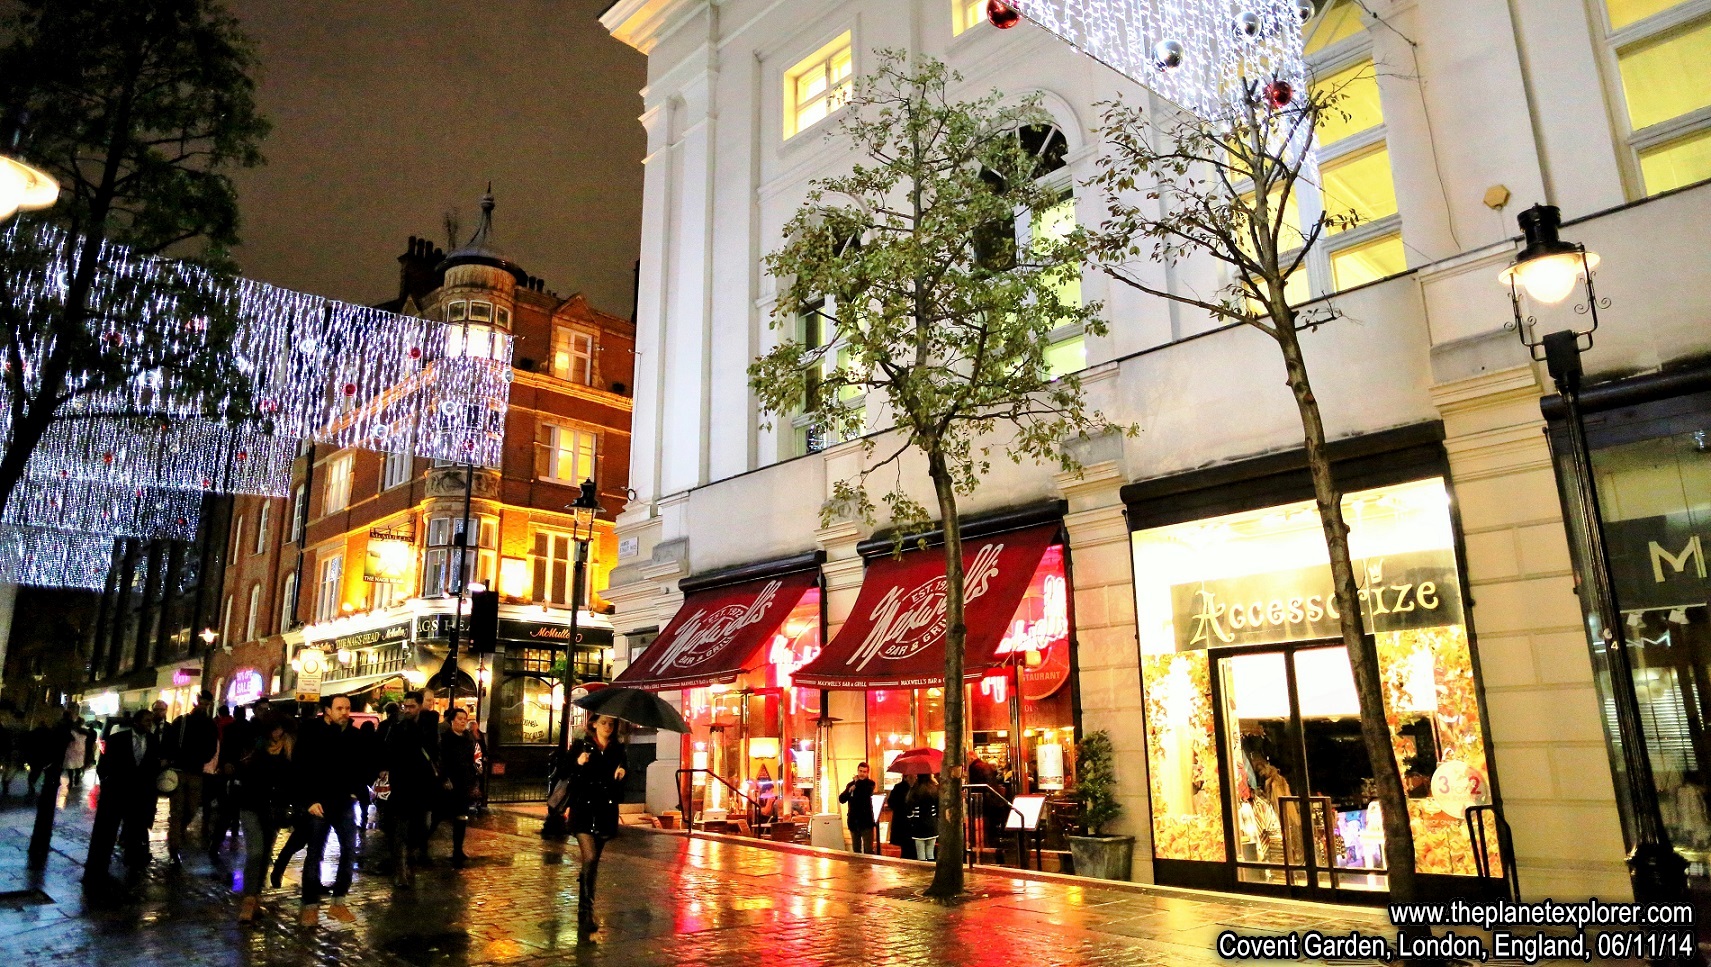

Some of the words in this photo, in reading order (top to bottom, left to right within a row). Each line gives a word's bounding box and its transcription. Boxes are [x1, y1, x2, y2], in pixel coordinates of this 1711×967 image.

[911, 588, 934, 603] EST.
[362, 631, 380, 644] HEAD
[885, 645, 905, 655] BAR
[1610, 640, 1619, 650] 4
[1438, 775, 1450, 794] 3
[1468, 775, 1481, 795] 2
